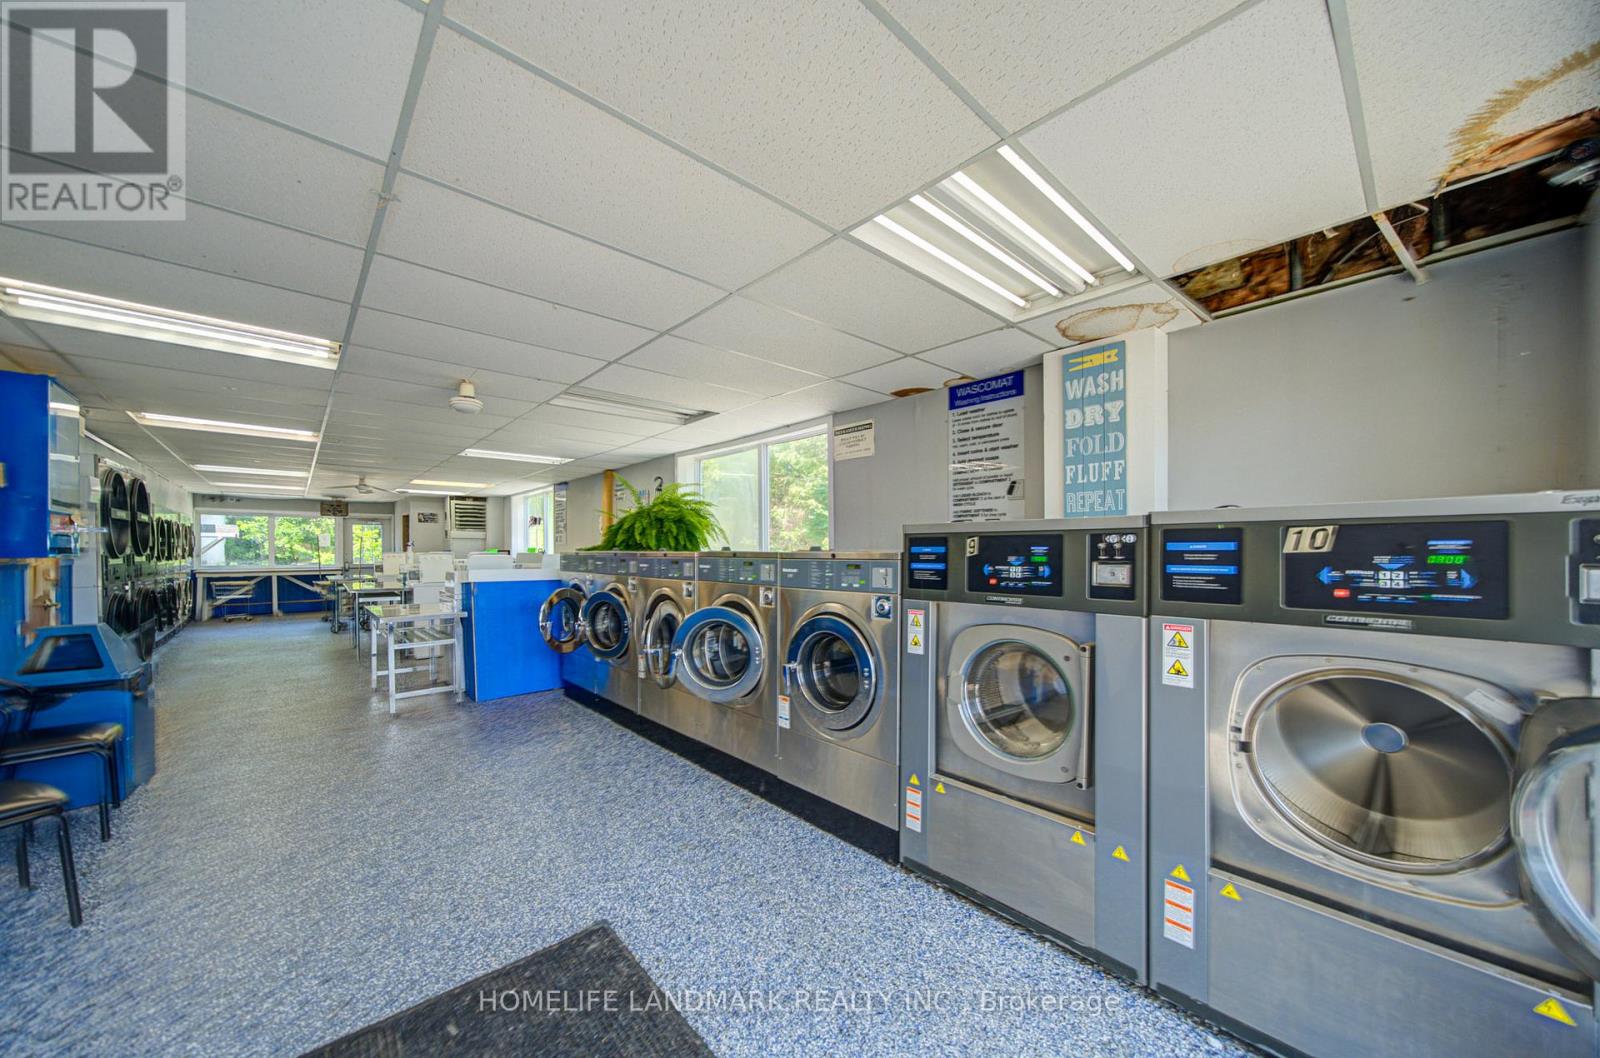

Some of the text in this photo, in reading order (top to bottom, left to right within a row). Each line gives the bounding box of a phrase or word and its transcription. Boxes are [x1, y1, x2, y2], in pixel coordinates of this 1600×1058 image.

[956, 376, 1014, 397] WASCOMAT
[1065, 368, 1124, 401] WASH
[1065, 400, 1124, 430] DRY
[1065, 431, 1125, 458] FOLD
[1065, 460, 1125, 484] FLUFF
[1066, 489, 1125, 512] REPEAT
[968, 539, 976, 554] 9
[1292, 528, 1330, 551] 10
